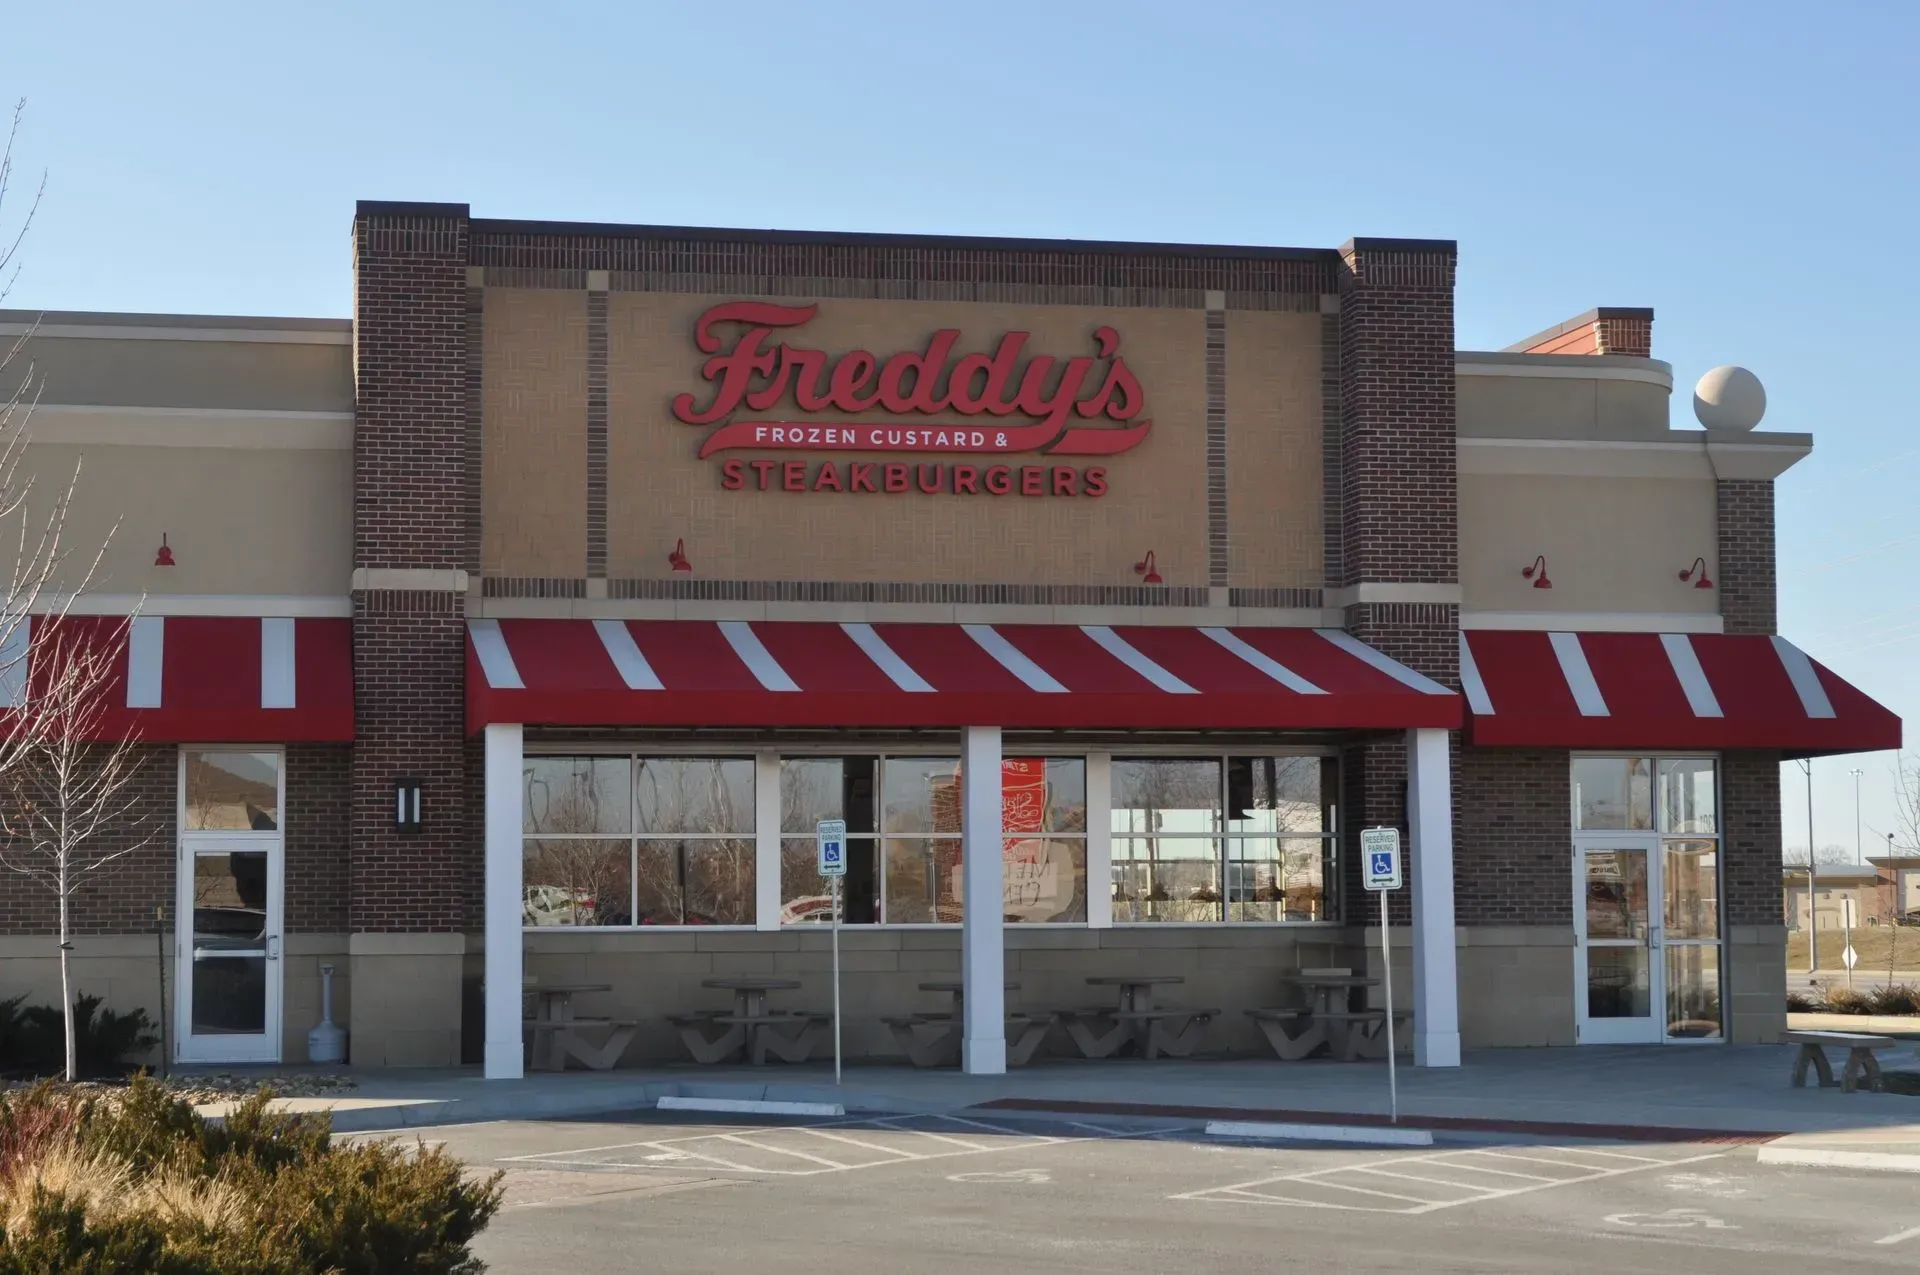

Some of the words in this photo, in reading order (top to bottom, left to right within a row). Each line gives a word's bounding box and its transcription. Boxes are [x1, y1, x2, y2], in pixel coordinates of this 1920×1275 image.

[673, 301, 1151, 456] Freddy's
[755, 427, 857, 444] FROZEN
[870, 429, 985, 447] CUSTARD
[994, 431, 1008, 448] &
[721, 458, 1109, 498] STEAKBURGERS
[1365, 835, 1395, 843] RESERVED
